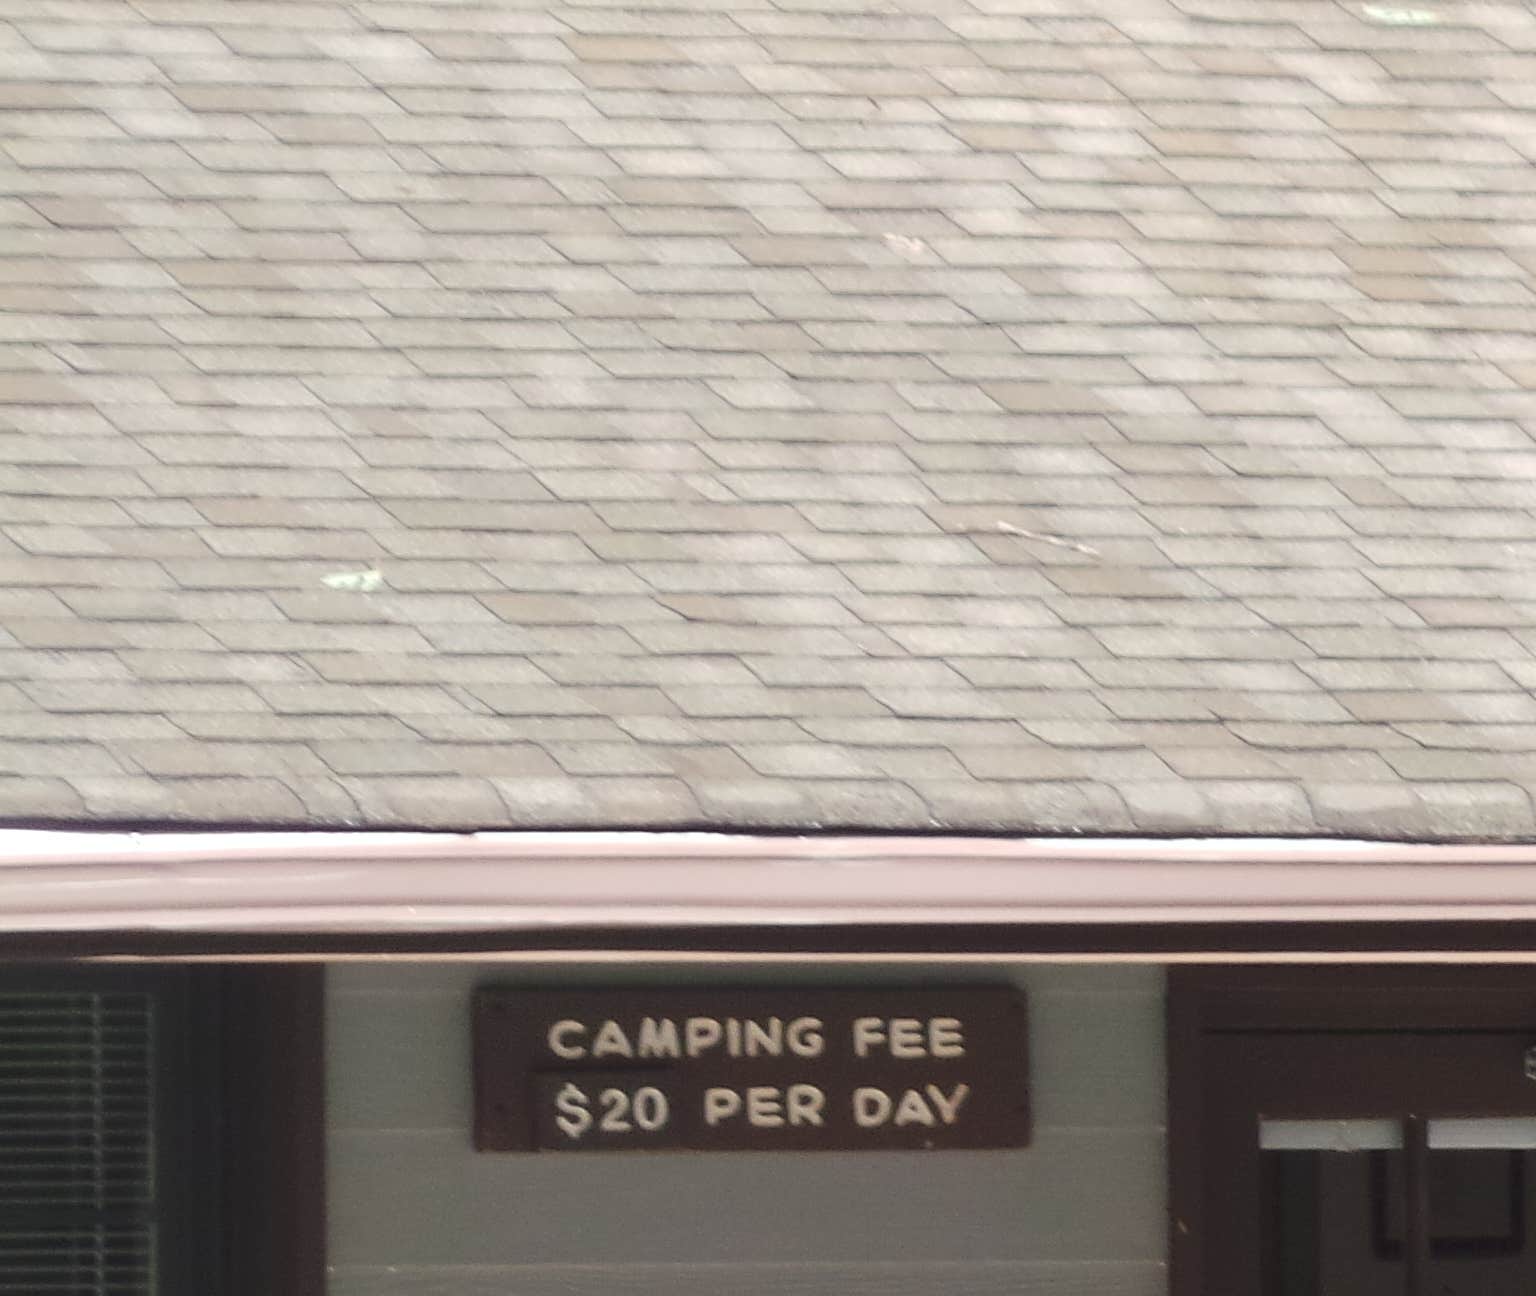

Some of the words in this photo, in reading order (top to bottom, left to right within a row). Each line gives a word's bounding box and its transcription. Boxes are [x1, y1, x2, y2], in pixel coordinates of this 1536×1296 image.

[547, 1017, 825, 1060] CAMPING
[853, 1017, 966, 1058] FEE
[554, 1083, 670, 1139] $20
[703, 1084, 826, 1127] PER
[853, 1083, 969, 1128] DAY
